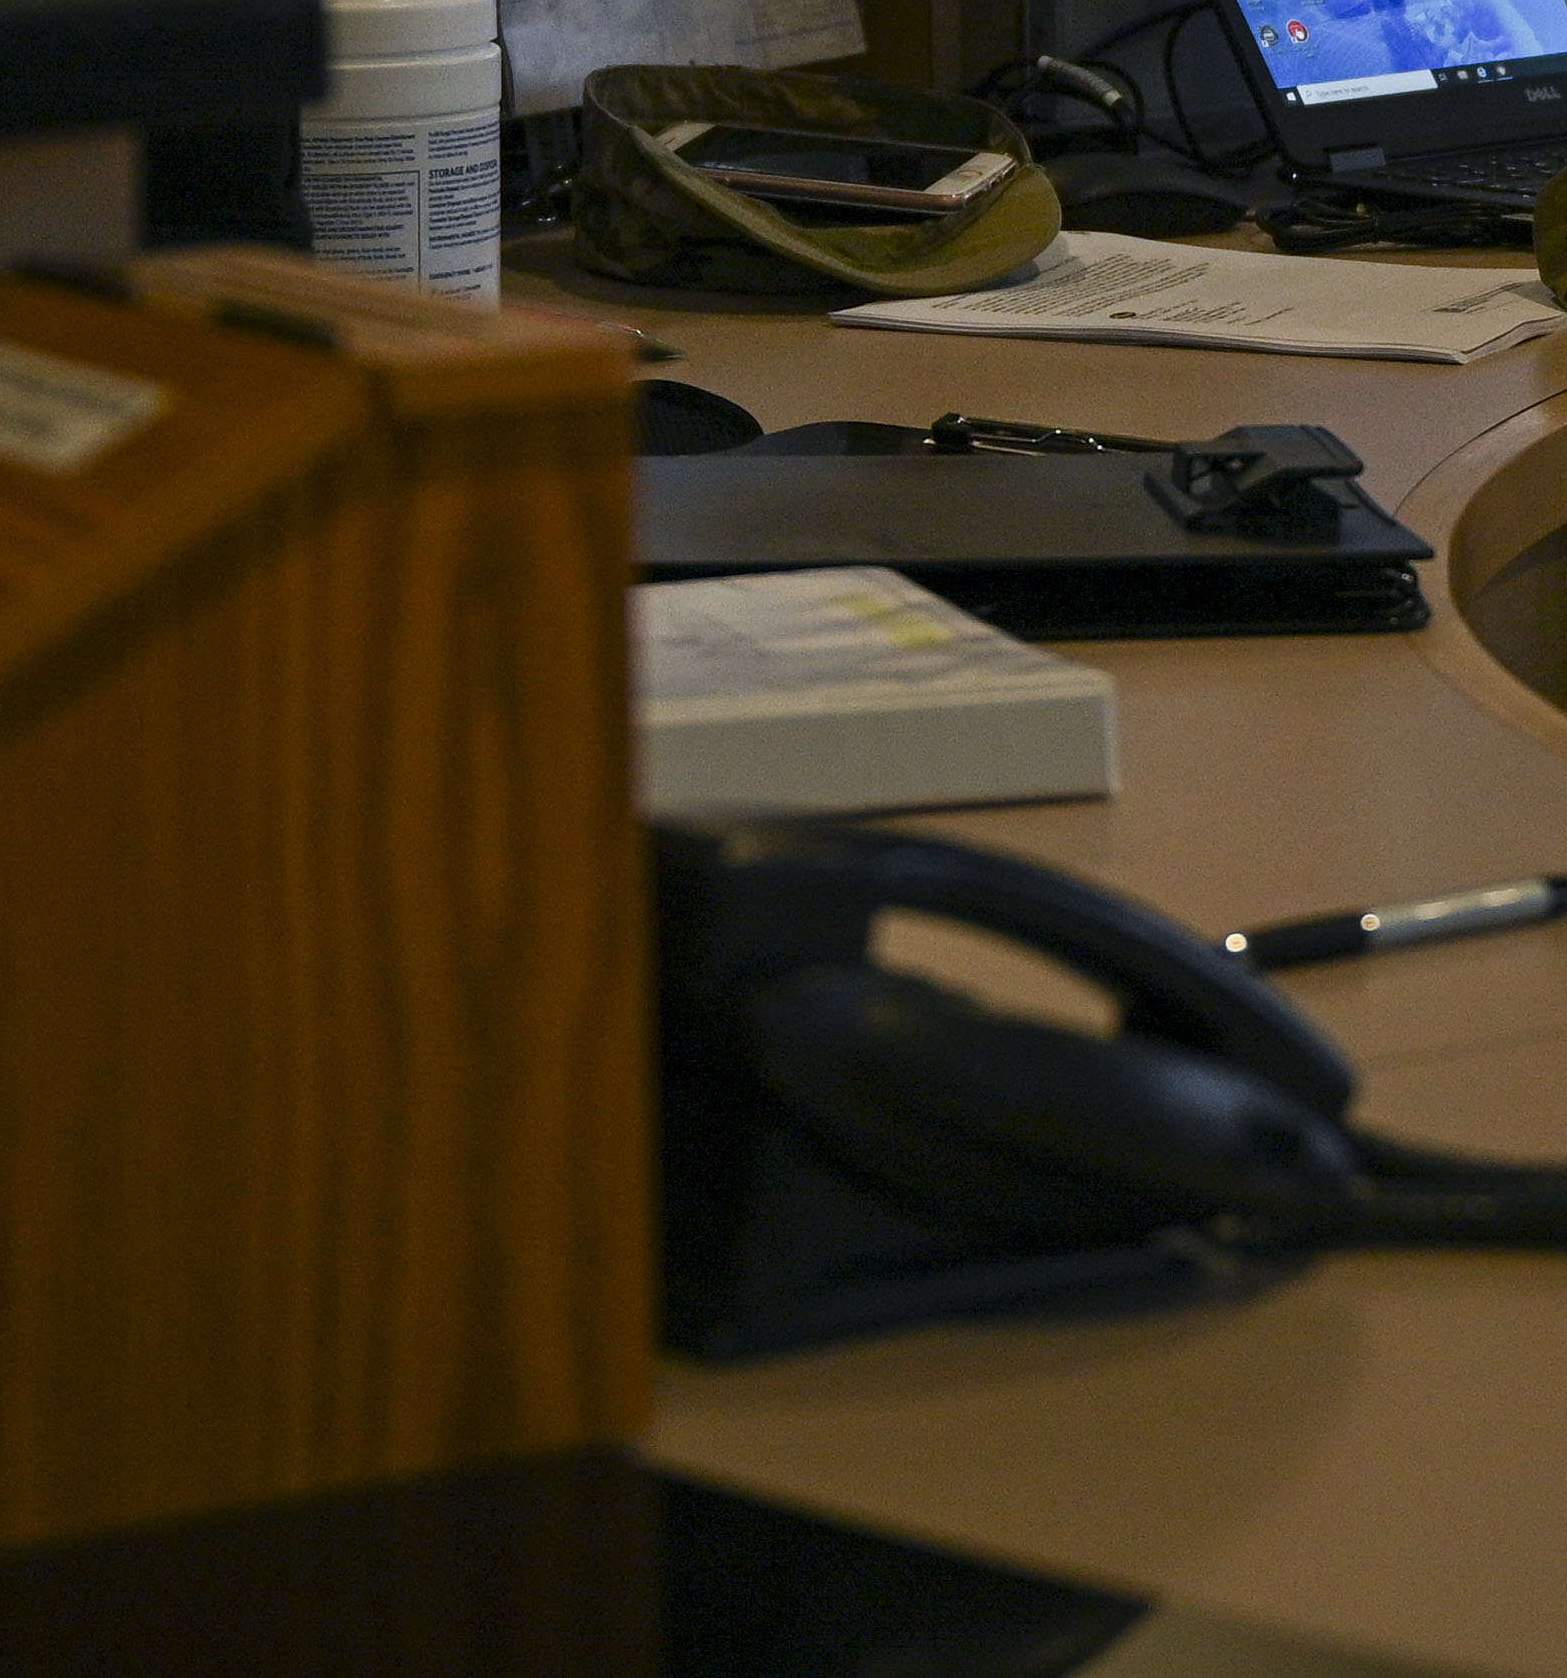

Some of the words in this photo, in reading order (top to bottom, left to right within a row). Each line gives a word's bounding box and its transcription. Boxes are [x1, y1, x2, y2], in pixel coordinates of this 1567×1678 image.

[1524, 86, 1562, 102] DELL
[428, 165, 464, 179] STORAGE
[465, 162, 478, 174] AND
